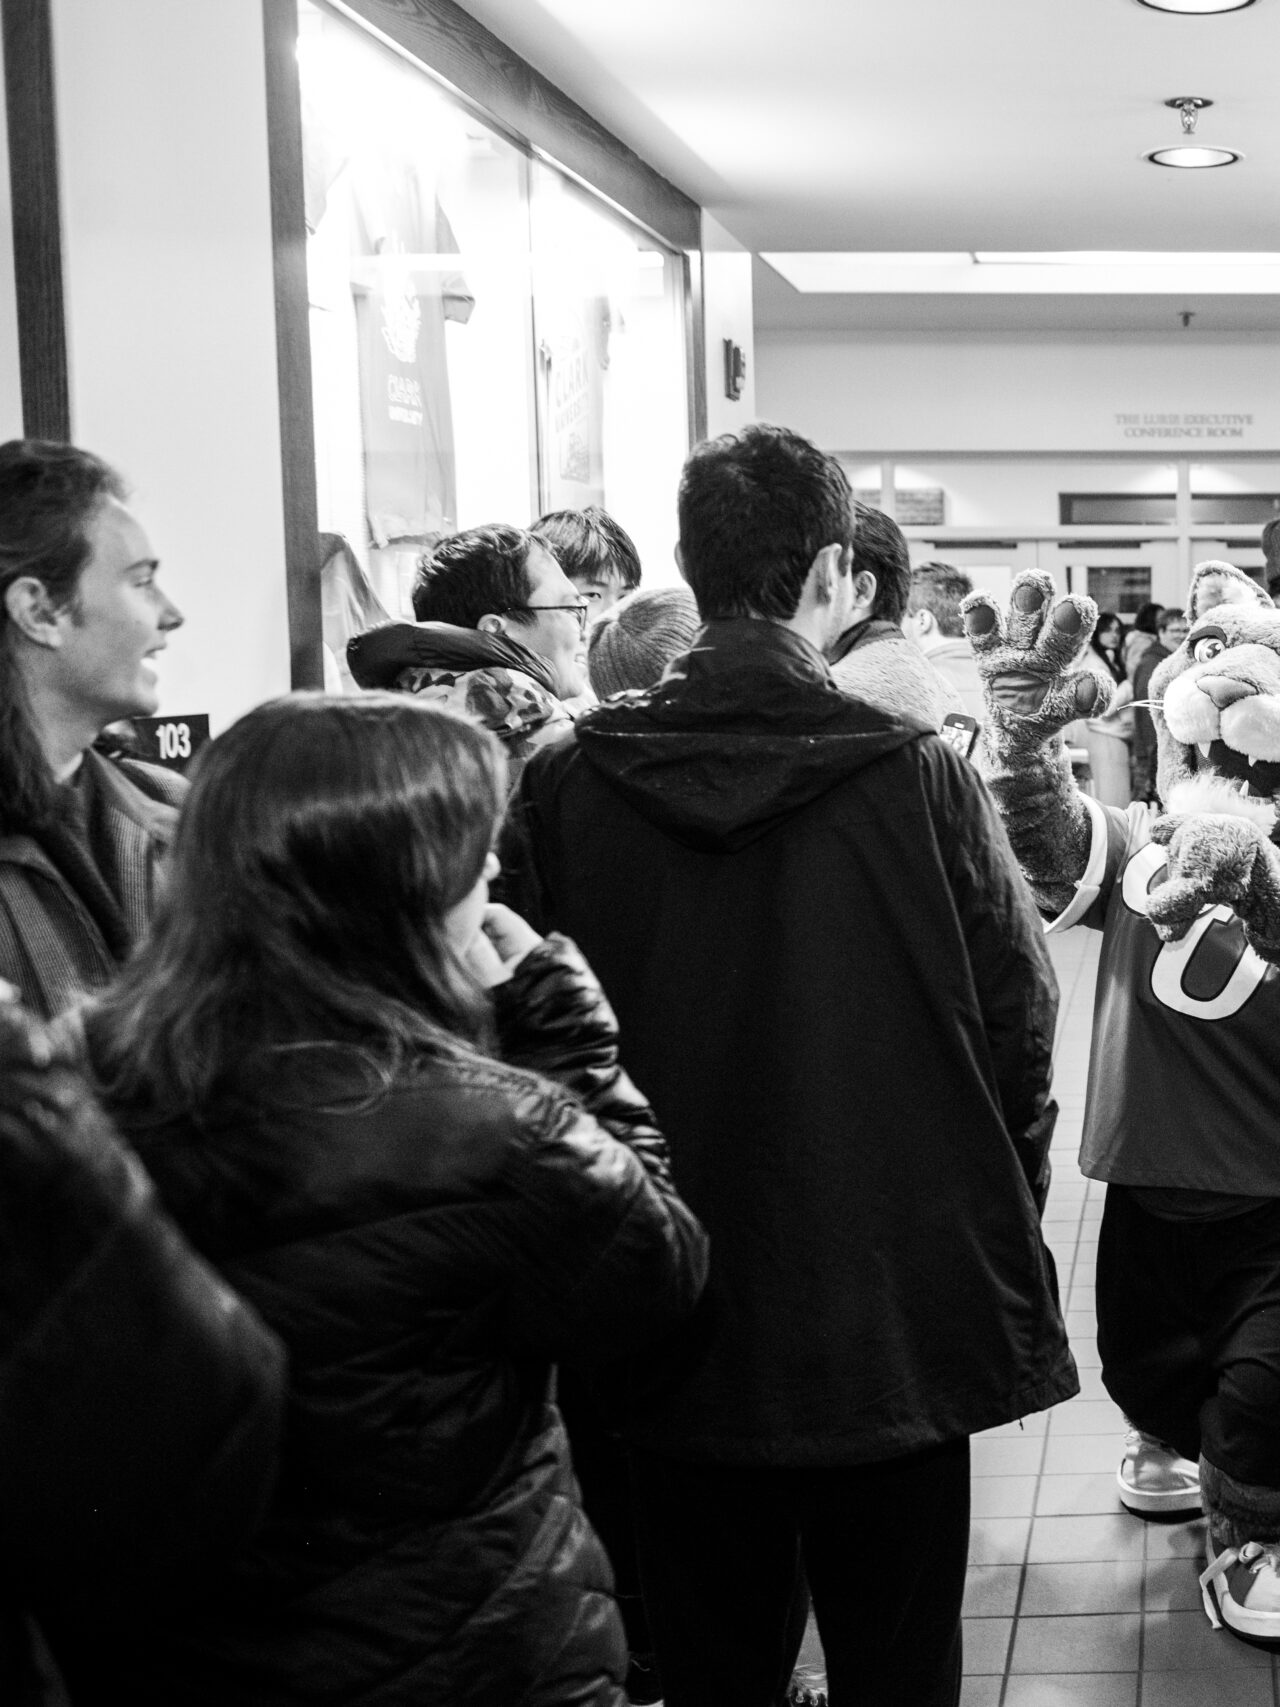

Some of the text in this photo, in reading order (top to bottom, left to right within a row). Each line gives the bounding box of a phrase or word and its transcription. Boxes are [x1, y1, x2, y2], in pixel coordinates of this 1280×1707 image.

[1115, 413, 1140, 425] THE
[1183, 413, 1253, 425] EXECUTIVE
[1124, 427, 1244, 438] CONFERENCE ROOM
[155, 722, 192, 760] 103
